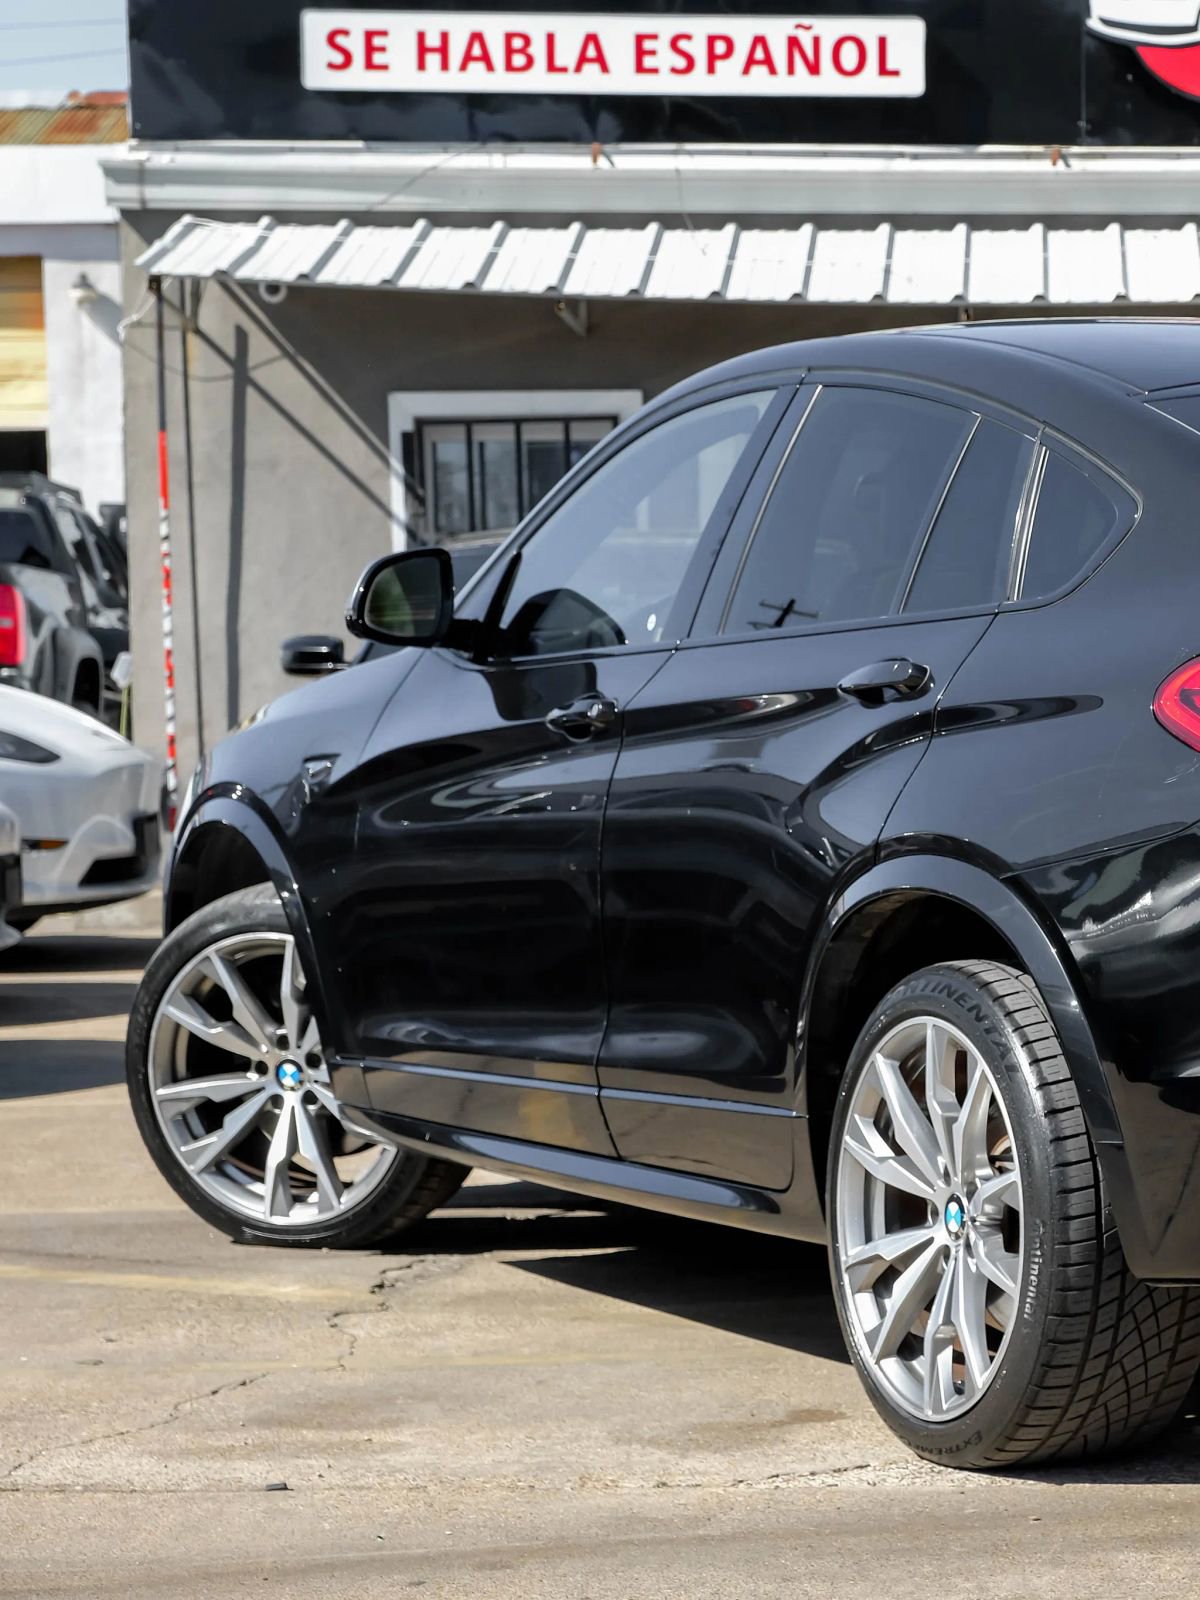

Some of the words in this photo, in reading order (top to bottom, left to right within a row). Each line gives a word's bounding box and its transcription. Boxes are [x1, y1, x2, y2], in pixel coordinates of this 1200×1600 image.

[325, 28, 391, 72] SE
[415, 31, 611, 75] HABLA
[633, 23, 901, 77] ESPAÑOL
[879, 980, 1020, 1083] ONTINENTAL
